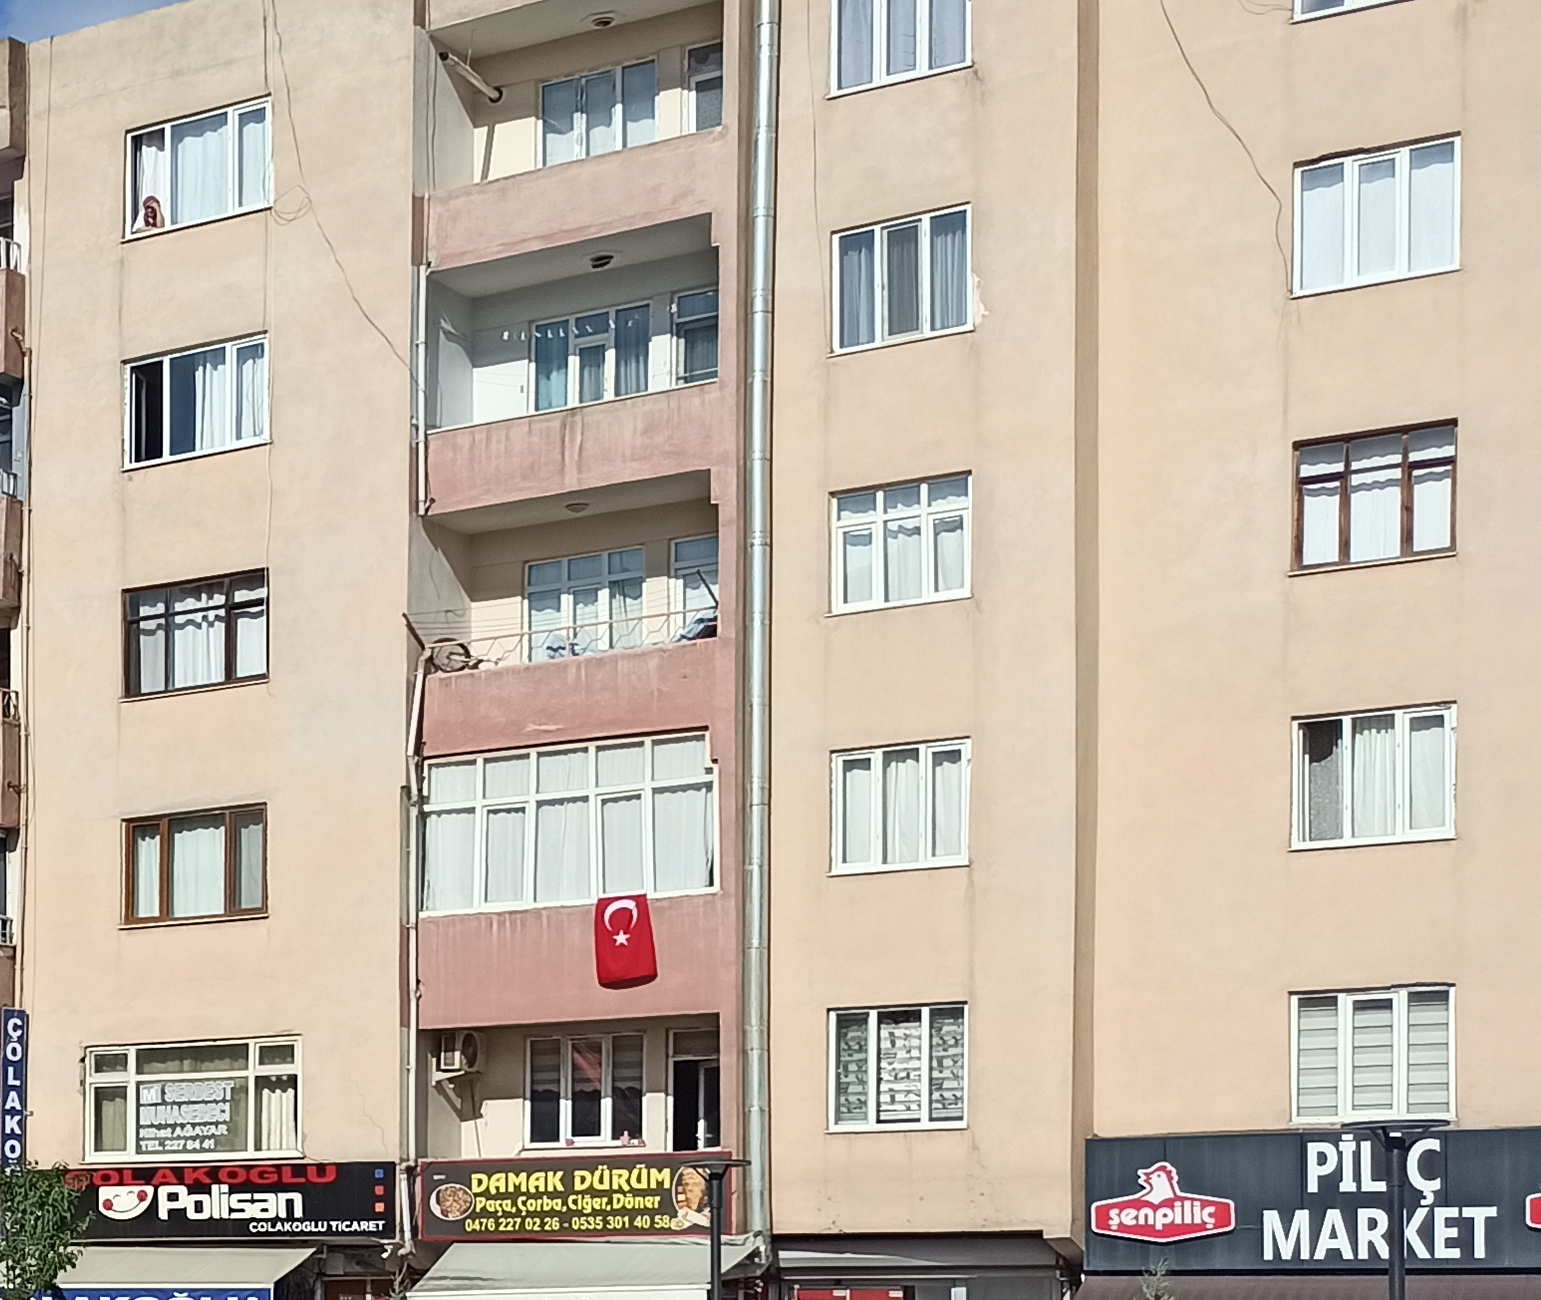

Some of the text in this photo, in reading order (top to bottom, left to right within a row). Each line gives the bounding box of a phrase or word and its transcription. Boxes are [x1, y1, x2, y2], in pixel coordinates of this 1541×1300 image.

[164, 1140, 185, 1150] 227
[471, 1163, 672, 1195] DAMAK DÜRÜM
[1307, 1133, 1441, 1206] PİLÇ
[157, 1184, 304, 1221] Polisan
[612, 1191, 661, 1209] Döner
[1108, 1200, 1216, 1231] şenpiliç
[465, 1218, 495, 1232] 0476
[498, 1217, 521, 1231] 227
[525, 1217, 541, 1231] 02
[543, 1216, 560, 1230] 26
[571, 1216, 603, 1231] 0535
[606, 1215, 630, 1230] 301
[633, 1214, 651, 1229] 40
[654, 1214, 670, 1229] 58
[1262, 1206, 1498, 1261] MARKET
